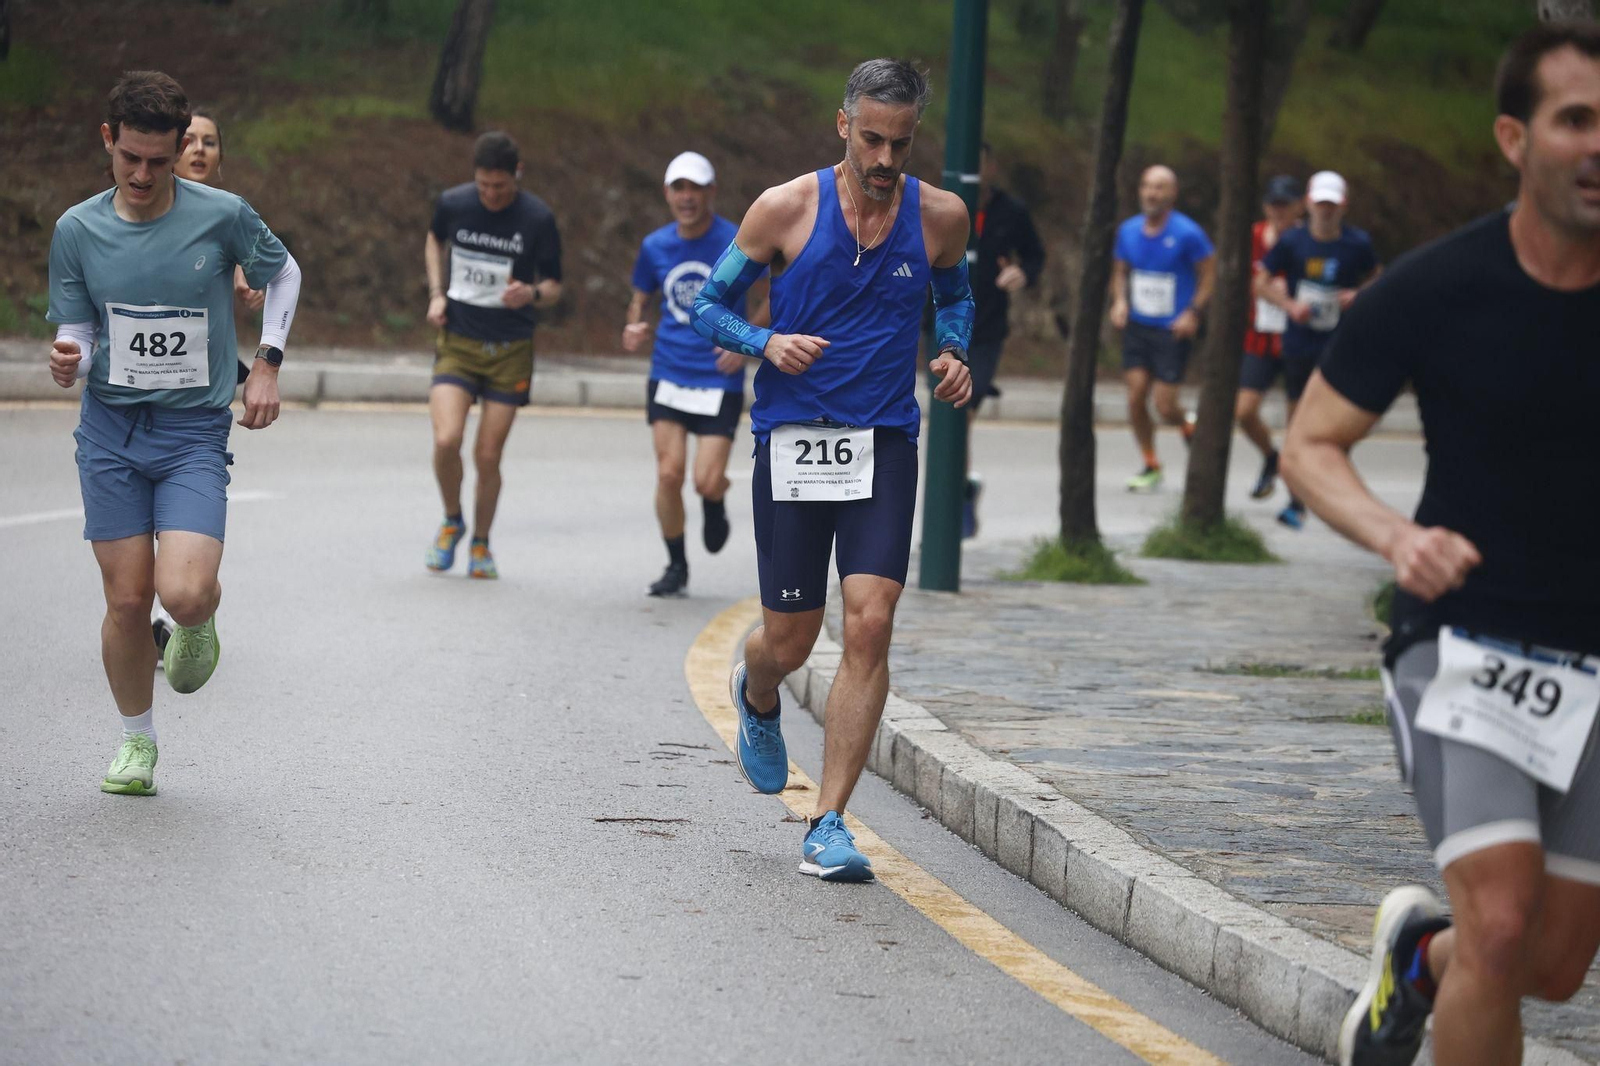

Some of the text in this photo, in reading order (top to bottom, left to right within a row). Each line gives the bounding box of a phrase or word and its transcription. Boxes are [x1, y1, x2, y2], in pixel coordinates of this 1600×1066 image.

[456, 228, 524, 254] GARMIN
[129, 331, 188, 357] 482
[795, 438, 853, 465] 216
[1470, 652, 1563, 719] 349
